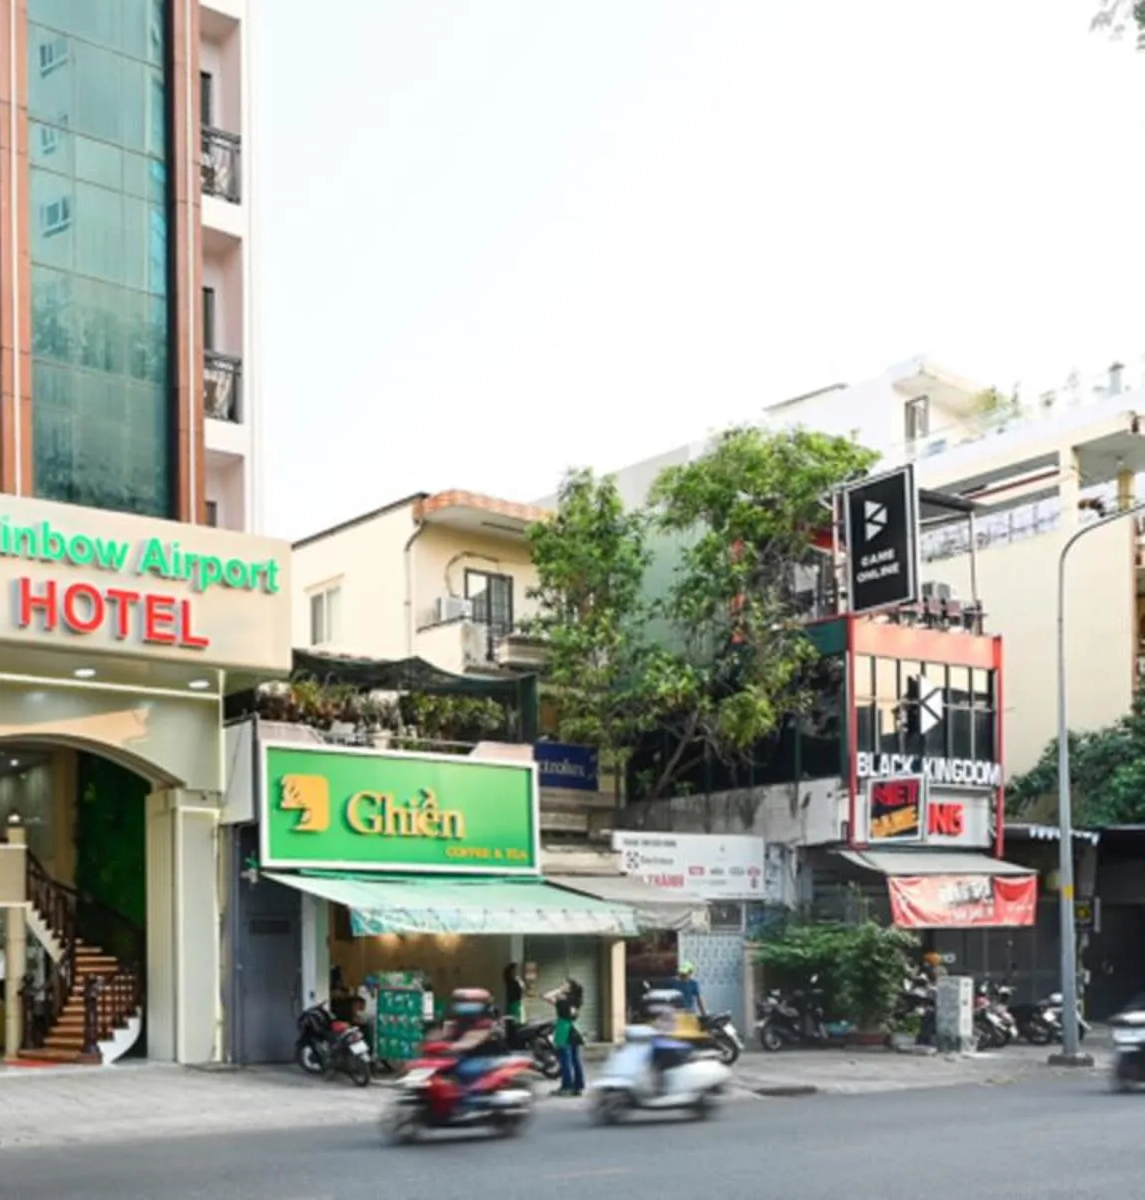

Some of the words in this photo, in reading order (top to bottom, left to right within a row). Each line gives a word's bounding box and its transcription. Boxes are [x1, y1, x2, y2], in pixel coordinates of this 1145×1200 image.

[139, 537, 279, 592] Airport
[856, 561, 900, 584] ONLINE
[18, 577, 209, 649] HOTEL
[856, 752, 914, 777] BLACK
[922, 756, 1003, 785] KINGDOM
[347, 786, 466, 840] Ghiền
